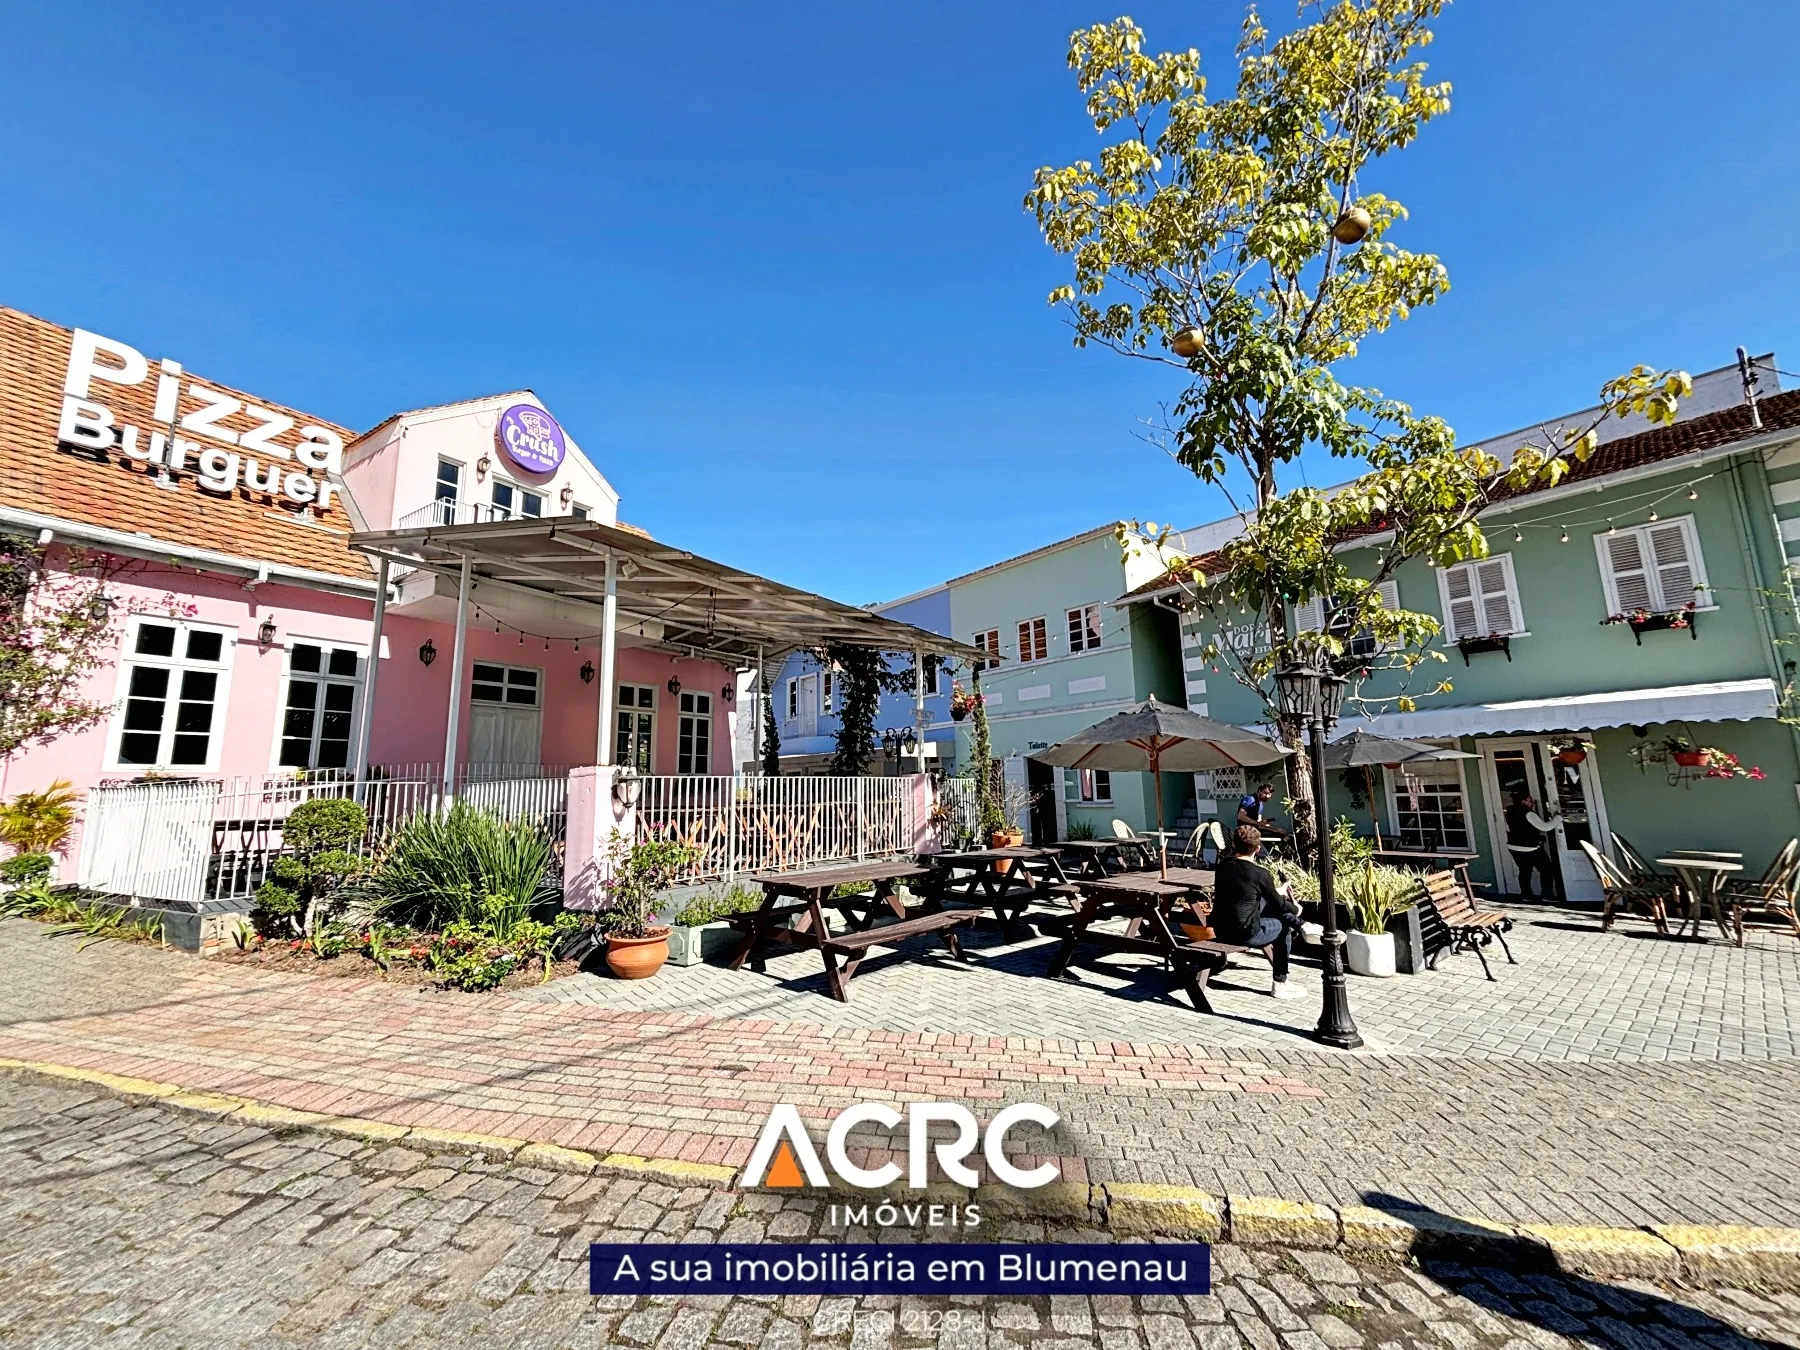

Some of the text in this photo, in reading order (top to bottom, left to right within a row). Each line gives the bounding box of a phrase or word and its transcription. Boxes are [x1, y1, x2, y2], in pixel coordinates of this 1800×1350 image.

[58, 396, 342, 508] Burguer
[63, 327, 343, 475] Pizza
[506, 424, 559, 462] Crush
